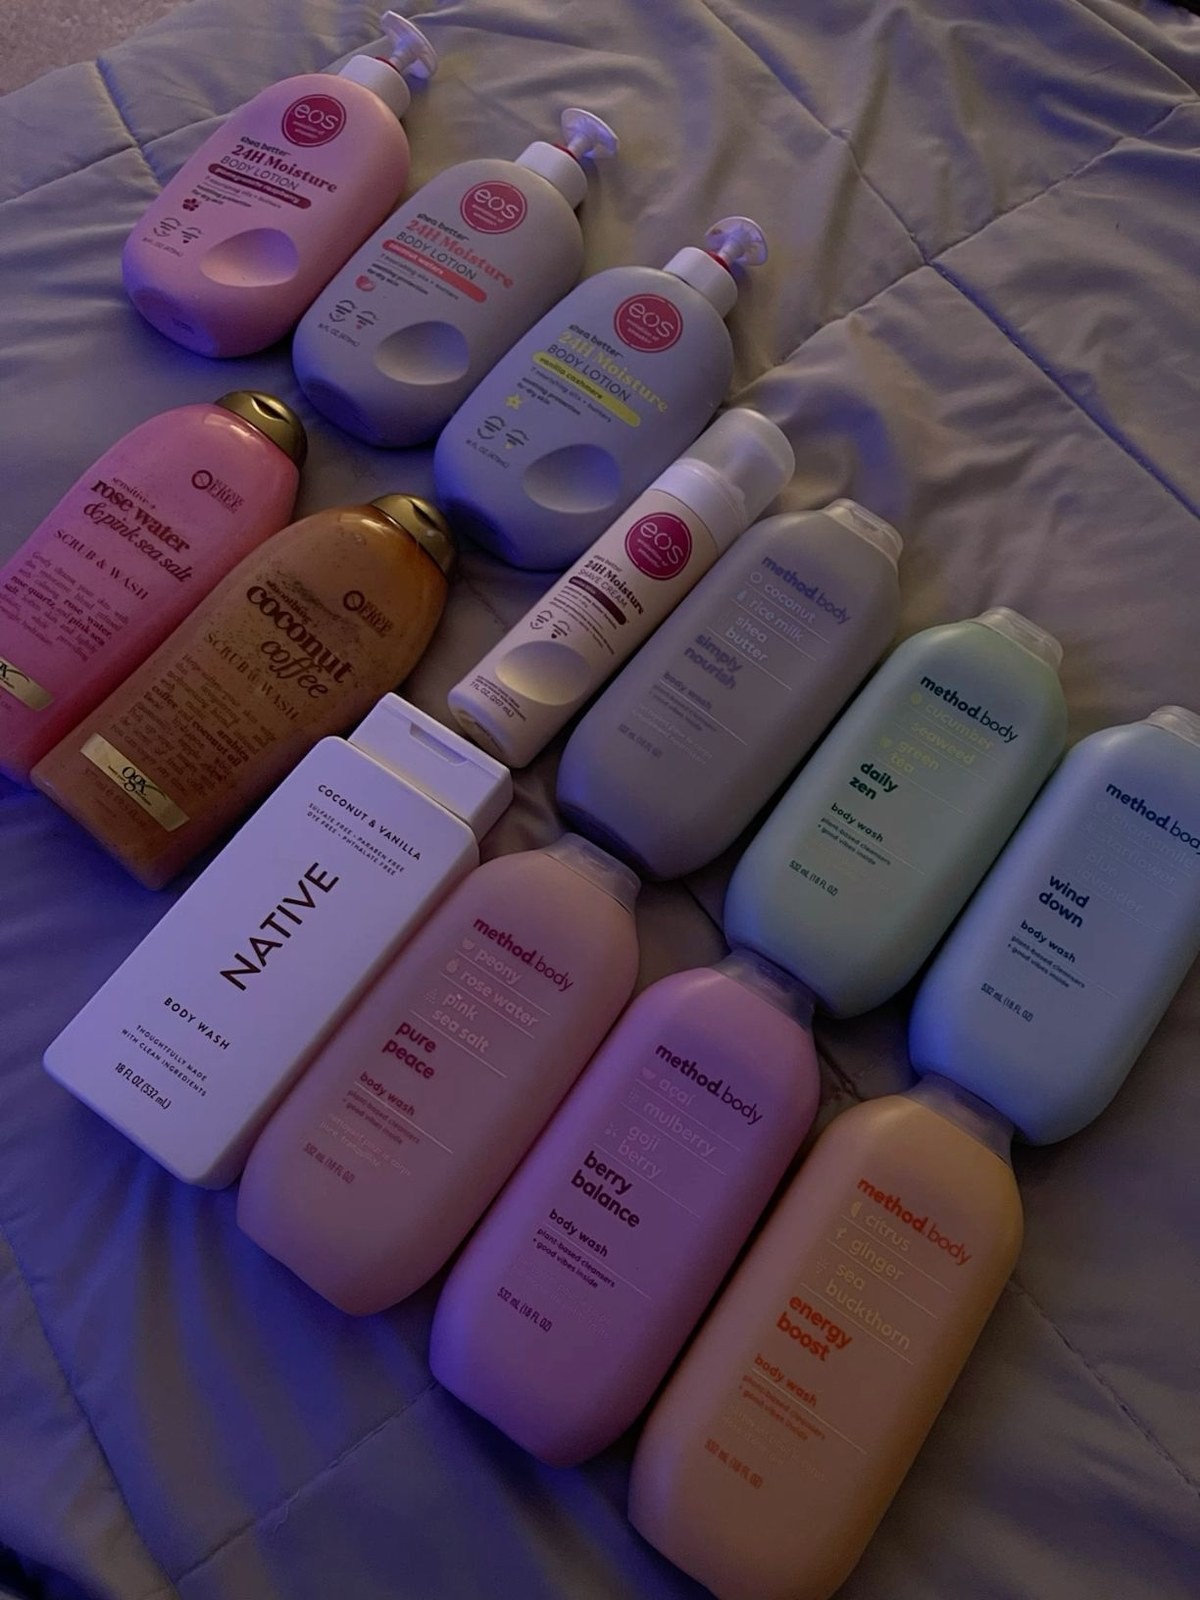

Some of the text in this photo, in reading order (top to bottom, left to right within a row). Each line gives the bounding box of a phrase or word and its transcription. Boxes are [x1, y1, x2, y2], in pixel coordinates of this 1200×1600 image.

[294, 102, 339, 130] eos
[240, 136, 260, 148] shea
[220, 155, 299, 190] BODY LOTION
[231, 144, 266, 163] 24H
[264, 155, 337, 192] Moisture
[416, 213, 437, 226] shea
[474, 188, 519, 219] eos
[396, 231, 477, 280] BODY LOTION
[405, 219, 515, 289] 24H Moisture
[568, 324, 590, 339] shea
[628, 302, 674, 337] eos
[539, 357, 603, 399] vanilla cashmere
[547, 344, 631, 401] BODY LOTION
[557, 331, 594, 357] 24H
[592, 351, 667, 411] Moisture
[112, 477, 148, 503] sensitive
[209, 484, 237, 508] FREE
[90, 480, 190, 553] rose water
[94, 510, 141, 542] pink
[134, 539, 162, 560] sea
[159, 558, 192, 582] salt
[639, 520, 684, 564] eos
[57, 530, 96, 560] SCRUB
[110, 567, 148, 600] WASH
[578, 565, 601, 586] SHAVE
[607, 586, 628, 608] CREAM
[10, 576, 28, 588] rose
[27, 587, 55, 609] quartz,
[67, 616, 90, 634] pink
[90, 632, 105, 646] sea
[63, 599, 83, 615] rose
[266, 580, 312, 625] smoothing
[607, 570, 644, 614] Moisture
[764, 583, 815, 623] coconut
[246, 586, 353, 684] coconut
[725, 626, 768, 660] butter
[735, 616, 767, 643] shea
[749, 600, 803, 642] rice milk
[260, 640, 329, 699] coffee
[684, 647, 736, 689] nourish
[695, 634, 743, 673] simply
[208, 633, 249, 673] SCRUB
[262, 682, 300, 720] WASH
[663, 671, 687, 692] body
[151, 686, 242, 767] coffee coconut oil
[920, 676, 1018, 743] method.body
[925, 704, 995, 750] cucumber
[890, 752, 914, 773] tea
[898, 741, 939, 770] green
[911, 723, 976, 765] seaweed
[849, 776, 876, 800] zen
[860, 763, 898, 792] daily
[308, 802, 404, 872] SULFATE FREE PARABEN FREE
[318, 784, 368, 820] COCONUT
[379, 825, 420, 860] VANILLA
[831, 802, 883, 842] body wash
[1106, 784, 1200, 855] method.bod
[320, 820, 336, 833] FREE
[342, 835, 380, 863] PHTHALATE
[379, 862, 396, 876] FREE
[1038, 892, 1083, 928] down
[1049, 875, 1090, 908] wind
[219, 862, 339, 991] NATIVE
[1020, 920, 1075, 963] body wash
[474, 948, 522, 984] peony
[442, 993, 478, 1020] pink
[460, 970, 539, 1026] rose water
[164, 997, 230, 1050] BODY WASH
[394, 1022, 436, 1053] pure
[431, 1010, 488, 1053] sea salt
[122, 1029, 206, 1096] WITH CLEAN INGREDIENTS
[136, 1024, 207, 1081] THOUGHTFULLY MADE
[381, 1039, 434, 1079] peace
[140, 1082, 158, 1099] (532
[154, 1096, 171, 1110] mL)
[359, 1071, 414, 1116] body wash
[655, 1045, 763, 1125] method.body
[626, 1126, 661, 1151] goji
[643, 1102, 716, 1157] mulberry
[584, 1150, 632, 1195] berry
[617, 1139, 662, 1179] berry
[571, 1170, 640, 1227] balance
[549, 1208, 607, 1257] body wash
[865, 1215, 910, 1251] citrus
[536, 1228, 615, 1288] plant-based cleansers
[536, 1242, 556, 1258] good
[556, 1256, 576, 1272] vibes
[575, 1269, 598, 1288] inside
[835, 1264, 865, 1290] sea
[848, 1239, 904, 1280] ginger
[497, 1286, 512, 1302] 532
[539, 1317, 552, 1332] OZ)
[788, 1296, 852, 1350] energy
[825, 1278, 910, 1350] buckthorn
[776, 1311, 830, 1361] boost
[754, 1353, 816, 1407] body wash
